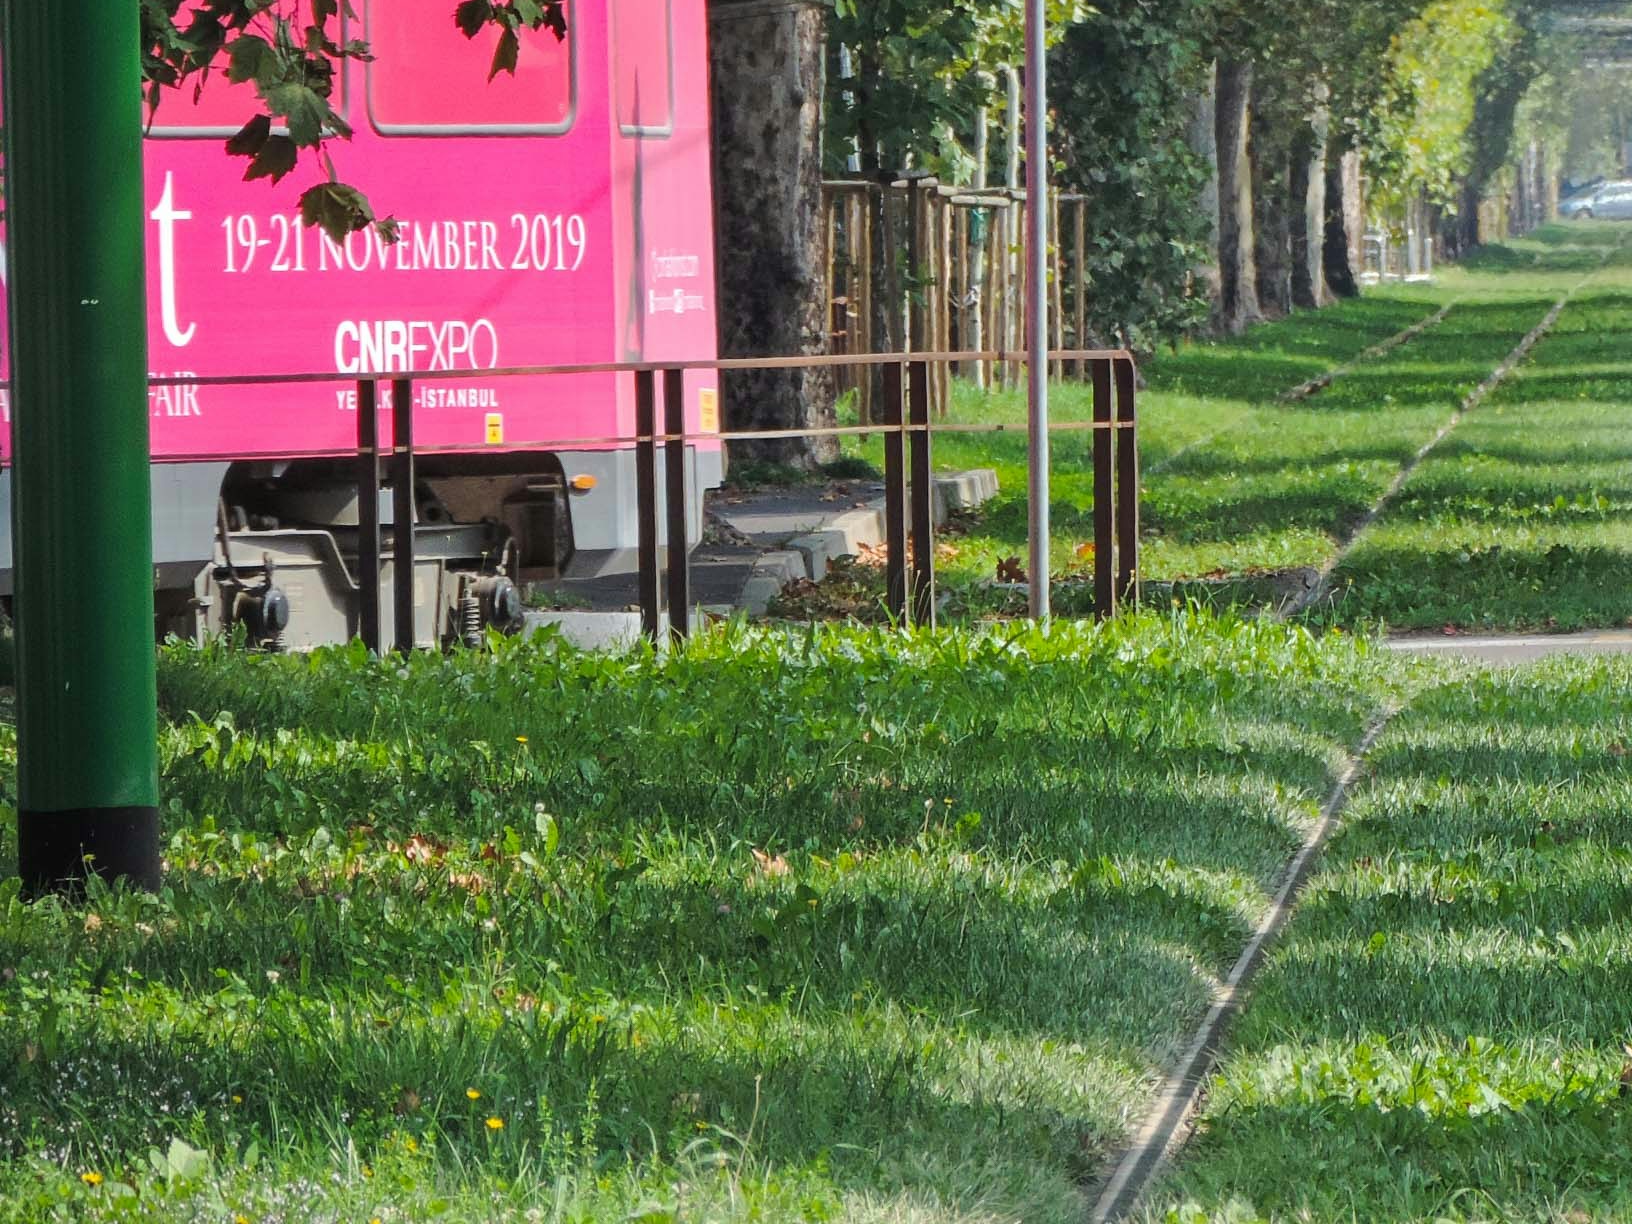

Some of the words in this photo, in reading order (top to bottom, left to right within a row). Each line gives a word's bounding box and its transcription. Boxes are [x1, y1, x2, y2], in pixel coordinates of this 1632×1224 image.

[221, 214, 305, 273] 19-21
[319, 220, 504, 272] NOVEMBER
[511, 213, 586, 272] 2019
